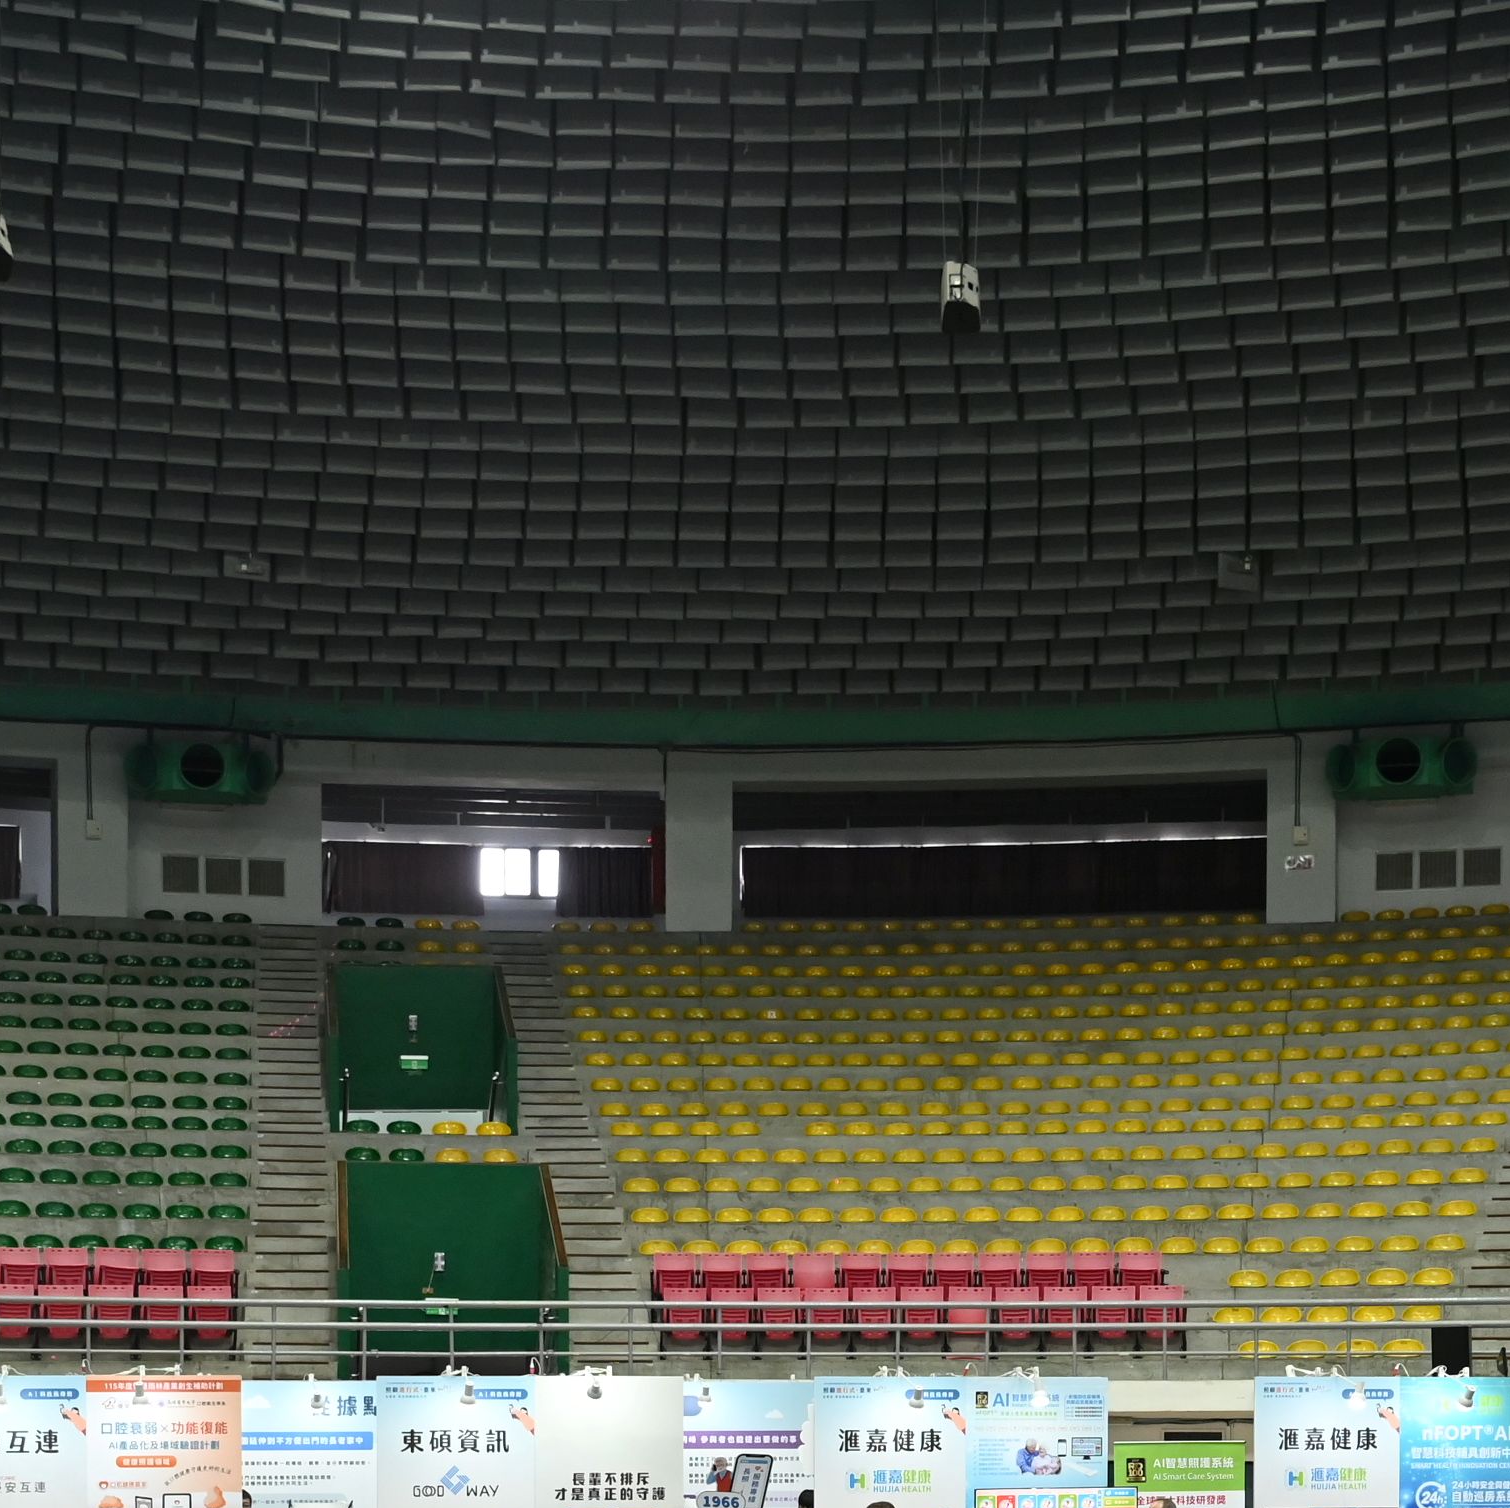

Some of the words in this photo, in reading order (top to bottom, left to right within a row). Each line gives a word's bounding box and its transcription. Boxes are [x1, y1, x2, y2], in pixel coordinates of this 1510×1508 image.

[401, 1429, 510, 1453] 東碩資訊
[838, 1428, 942, 1452] 滙嘉健康
[1278, 1427, 1378, 1451] 滙嘉健康
[572, 1472, 650, 1486] 長輩不排斥
[1207, 1473, 1234, 1481] System
[466, 1485, 500, 1497] WAY
[554, 1487, 666, 1501] 才是真正的守護
[702, 1495, 740, 1508] 1966
